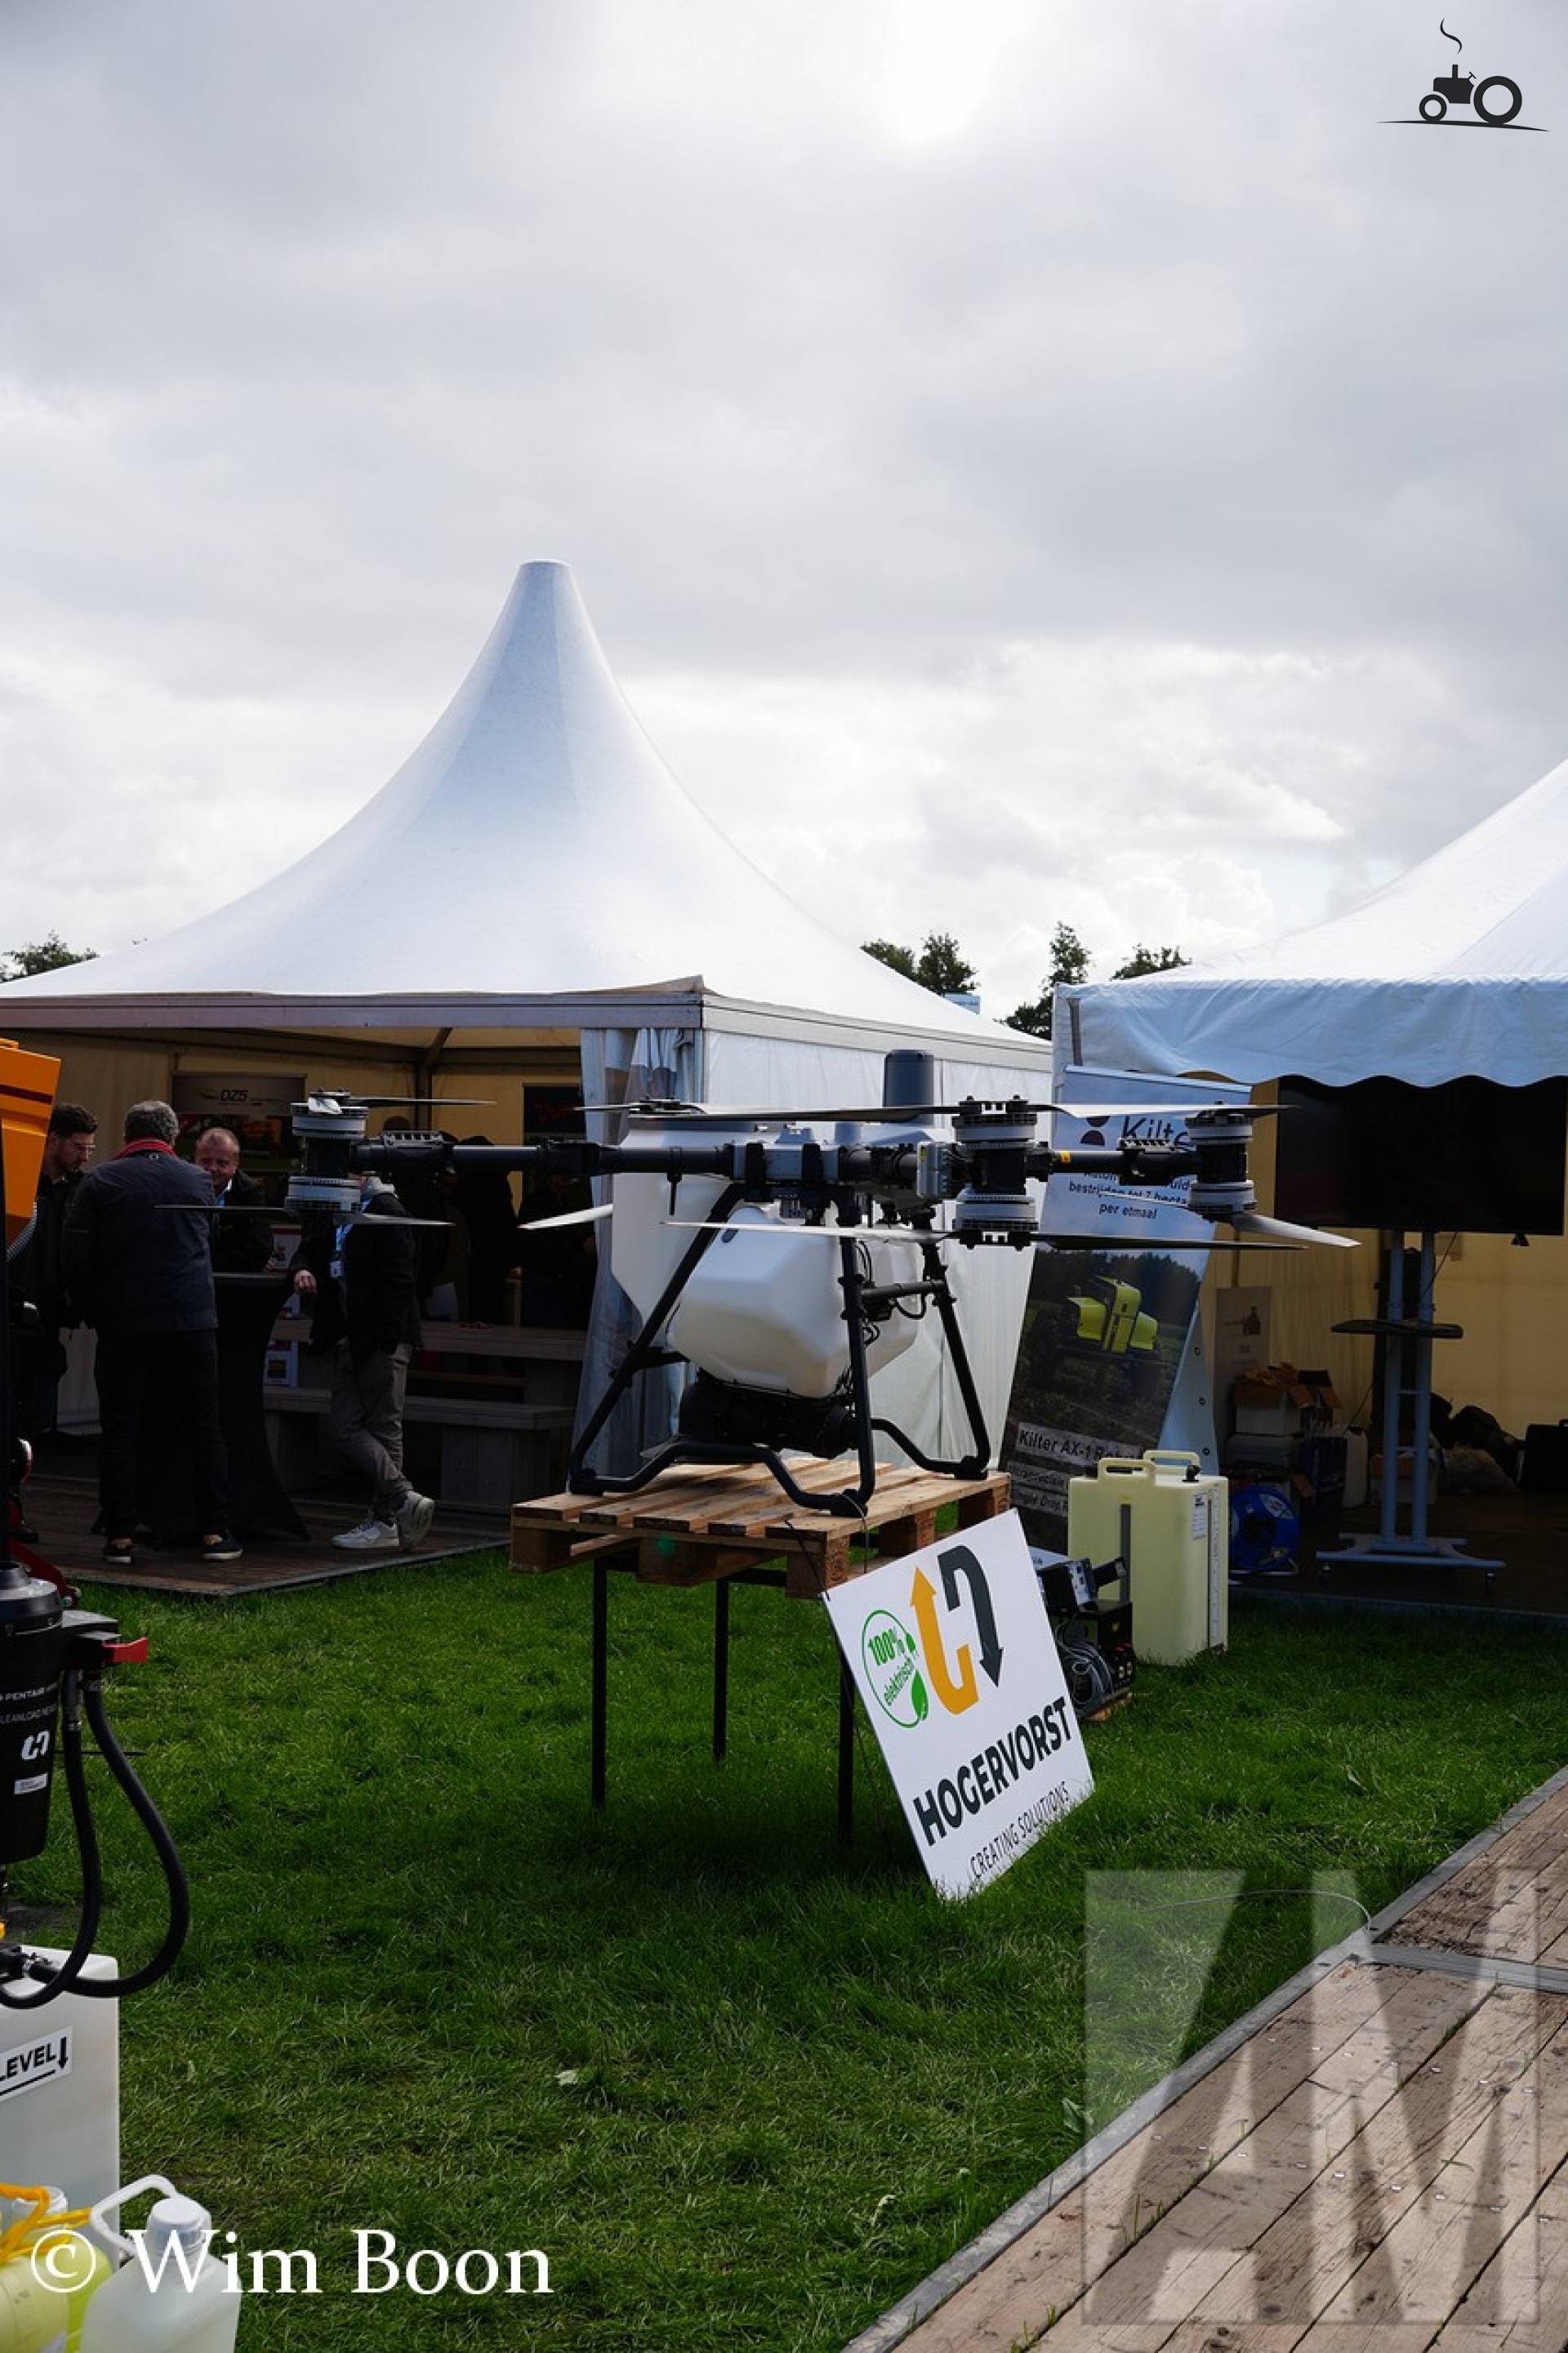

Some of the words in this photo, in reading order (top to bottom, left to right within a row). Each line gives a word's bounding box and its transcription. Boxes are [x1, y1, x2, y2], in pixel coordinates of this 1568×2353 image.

[1120, 1116, 1189, 1147] Kilte
[1098, 1203, 1120, 1216] per
[1123, 1206, 1158, 1219] etmaal
[868, 1627, 905, 1666] 100%
[913, 1696, 1071, 1847] HOGERVORST
[969, 1822, 1019, 1878] CREATING
[1018, 1780, 1069, 1839] SOLUTIONS
